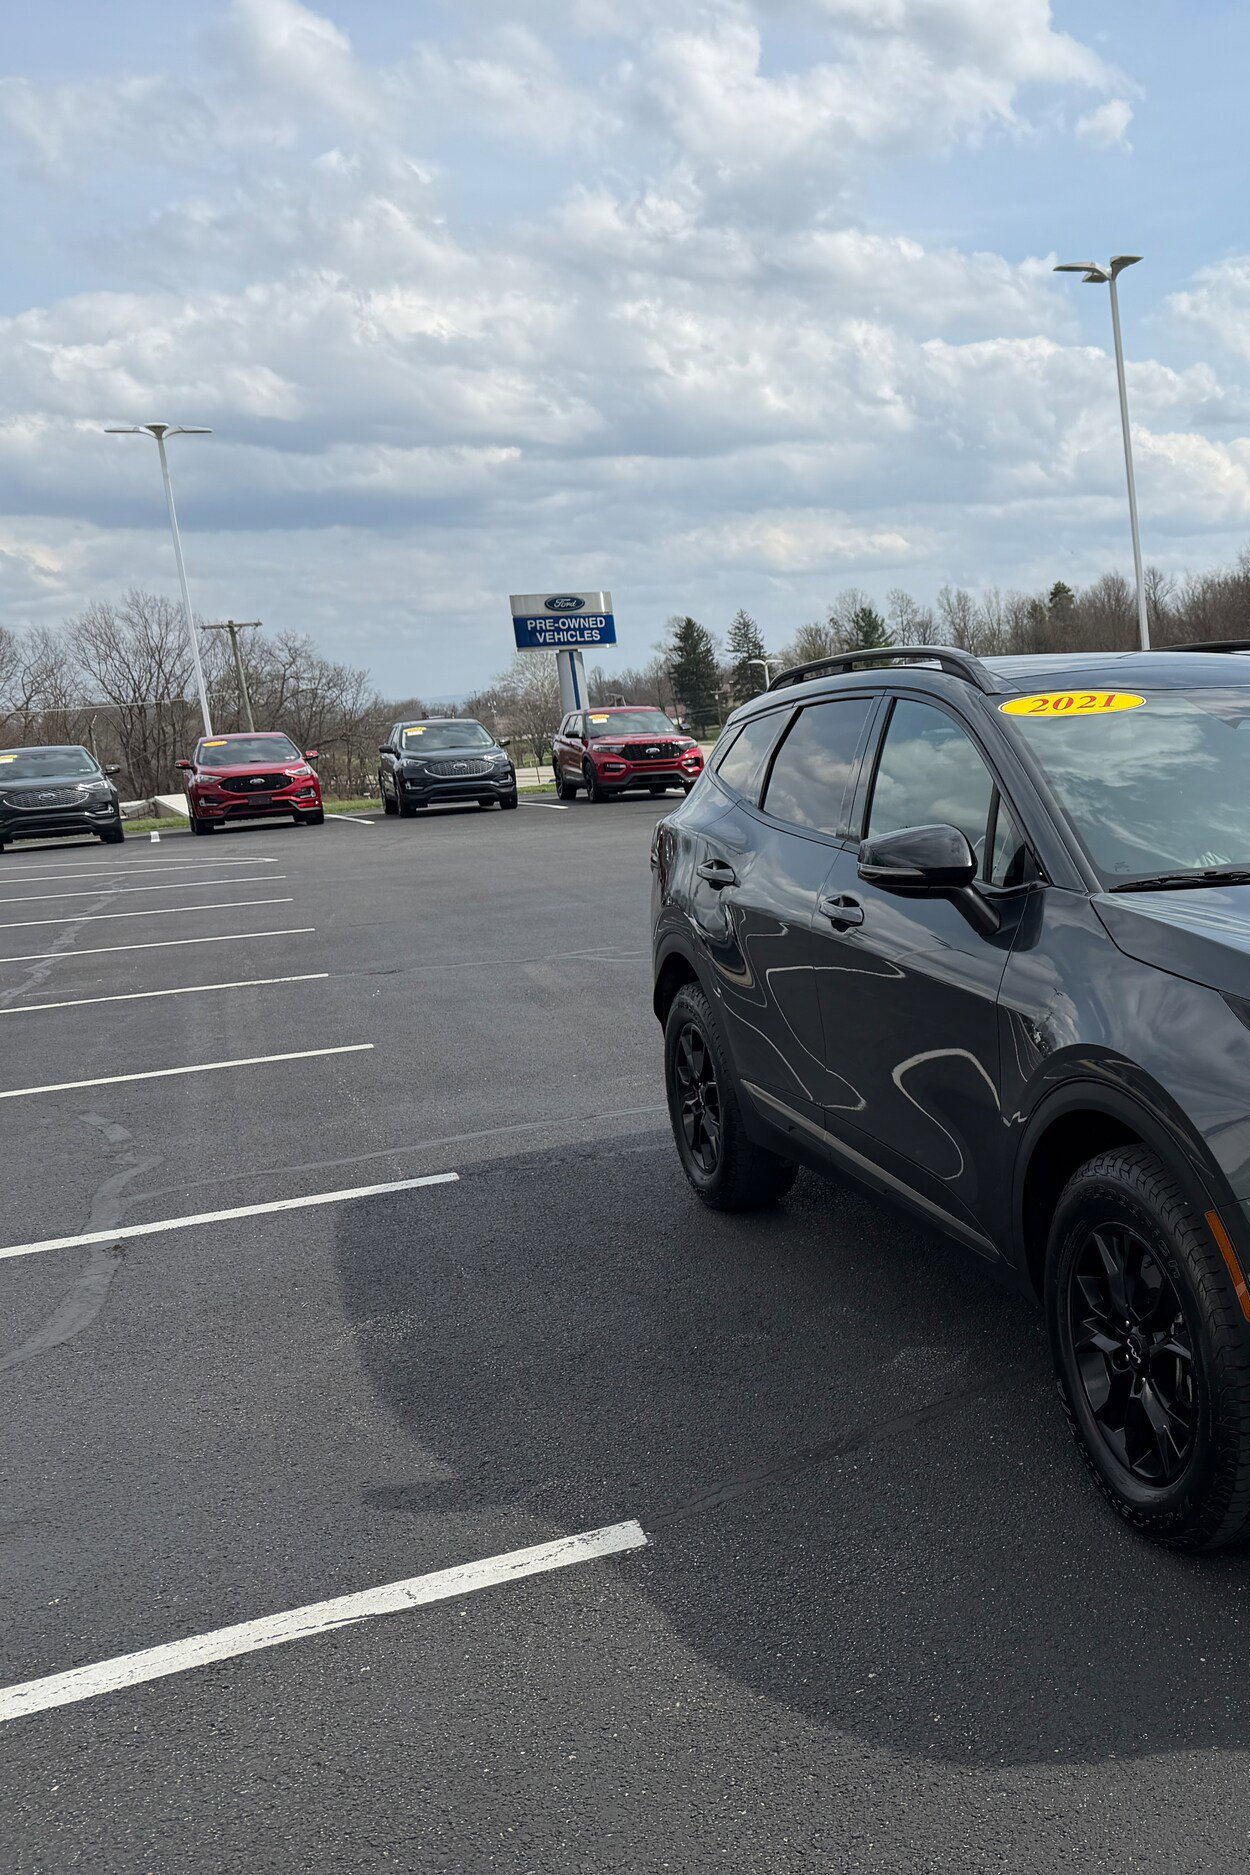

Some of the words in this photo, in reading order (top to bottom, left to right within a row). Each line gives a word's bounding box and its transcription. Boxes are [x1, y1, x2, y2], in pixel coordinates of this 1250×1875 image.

[527, 617, 605, 631] PRE-OWNED
[536, 630, 600, 643] VEHICLES
[1028, 694, 1116, 713] 2021
